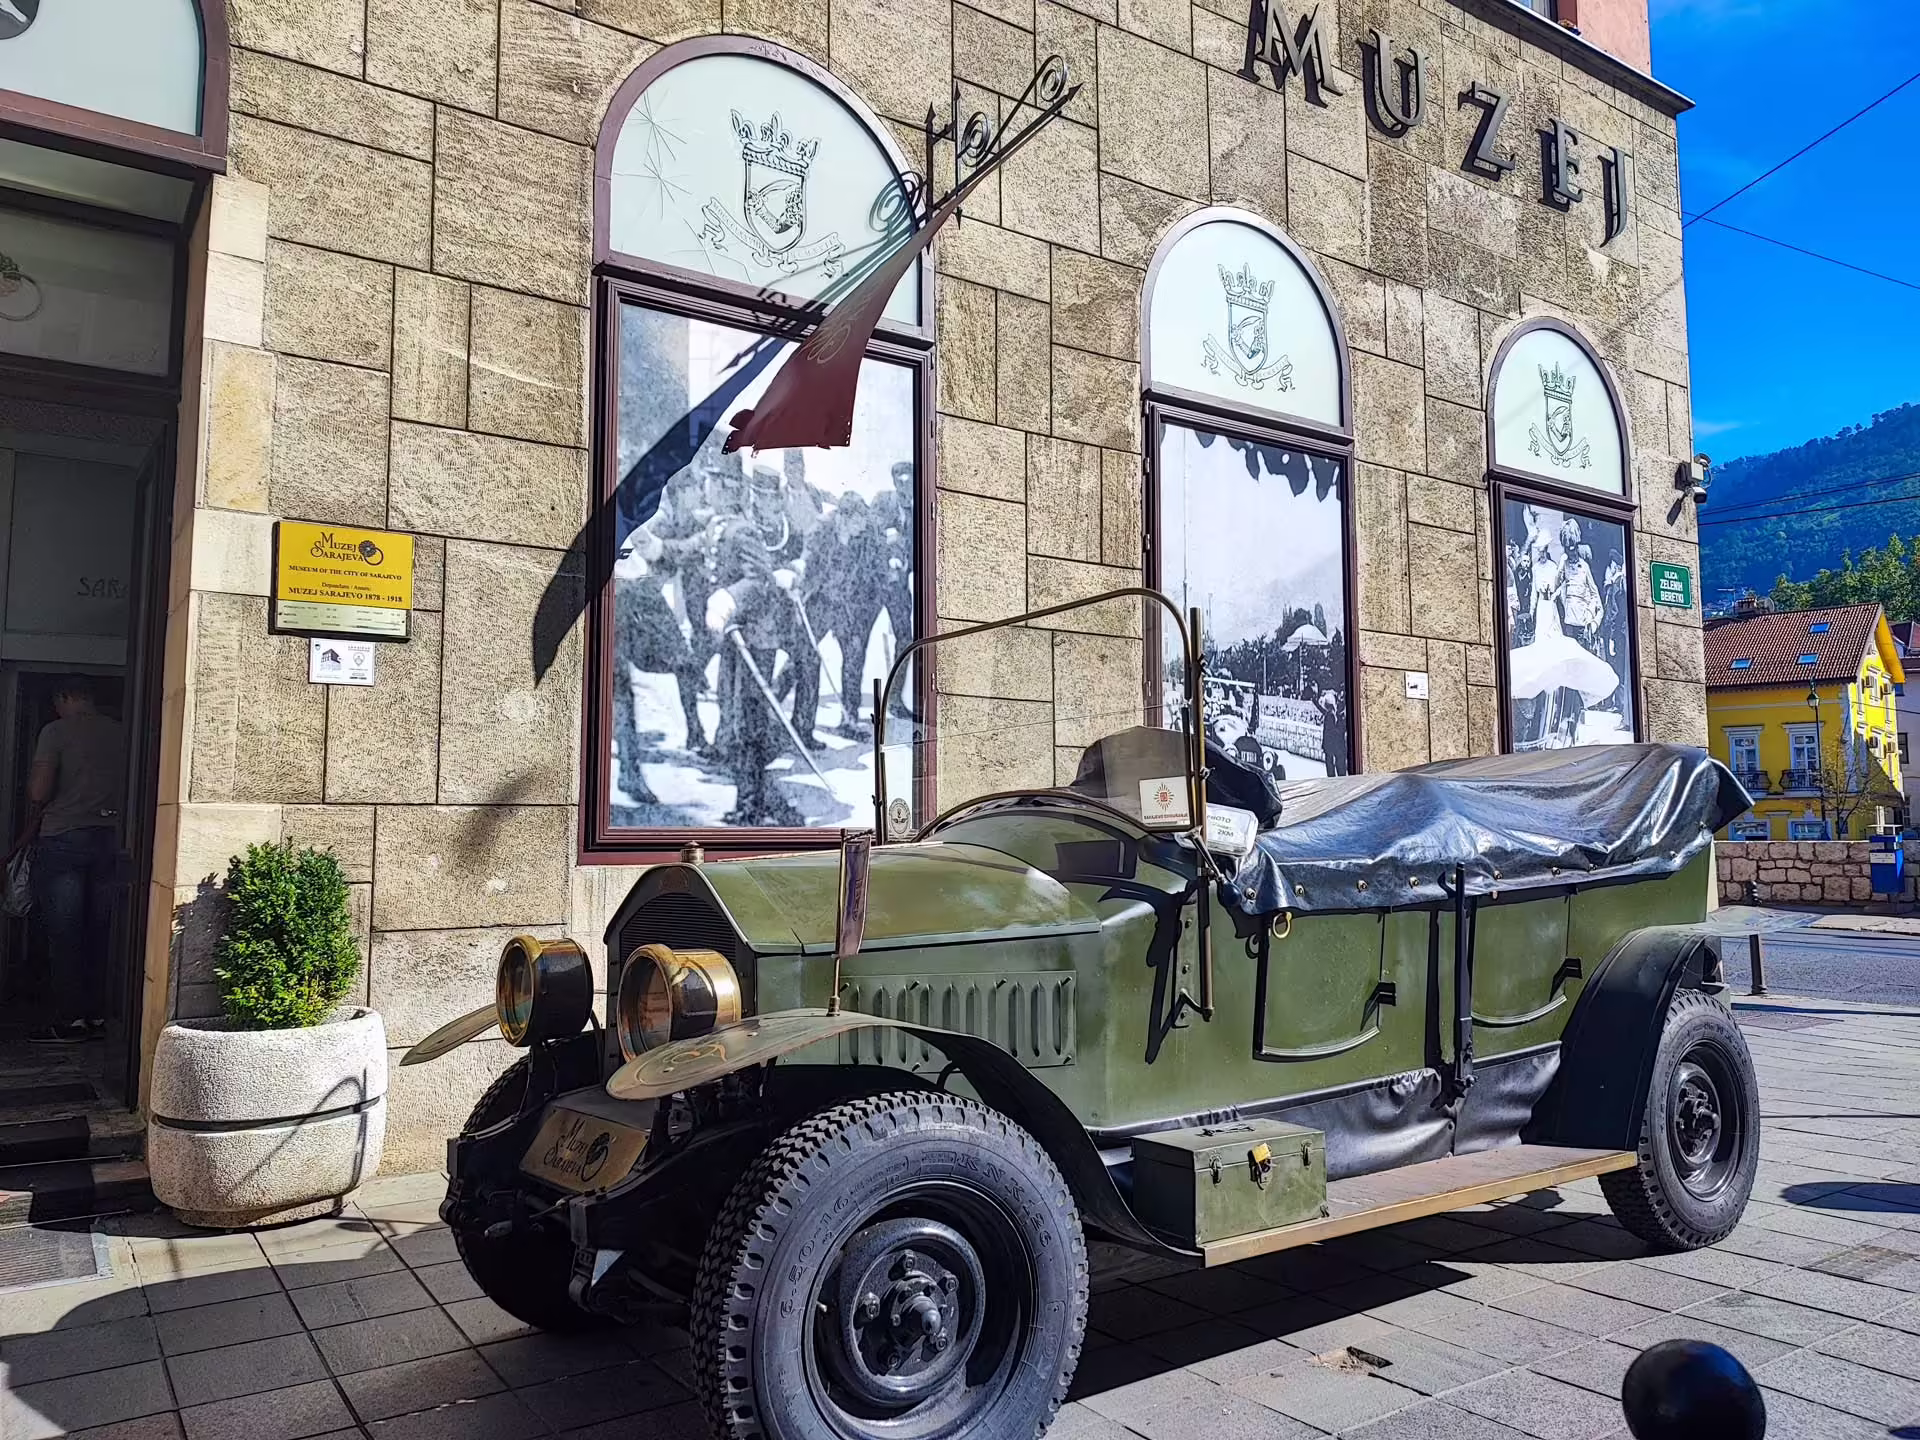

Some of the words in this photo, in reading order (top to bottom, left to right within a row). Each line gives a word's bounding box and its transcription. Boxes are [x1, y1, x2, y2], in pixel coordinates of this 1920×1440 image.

[1254, 0, 1633, 240] MUZEJ
[320, 532, 357, 553] MUZEJ
[310, 541, 364, 562] SARAJEVA
[288, 565, 318, 573] MUSEUM
[1664, 570, 1678, 580] ULICA
[1660, 579, 1683, 591] ZELENIH
[288, 587, 318, 596] MUZEJ
[319, 590, 363, 599] SARAJEVO
[364, 593, 381, 601] 1878
[1660, 590, 1684, 603] BERETKI
